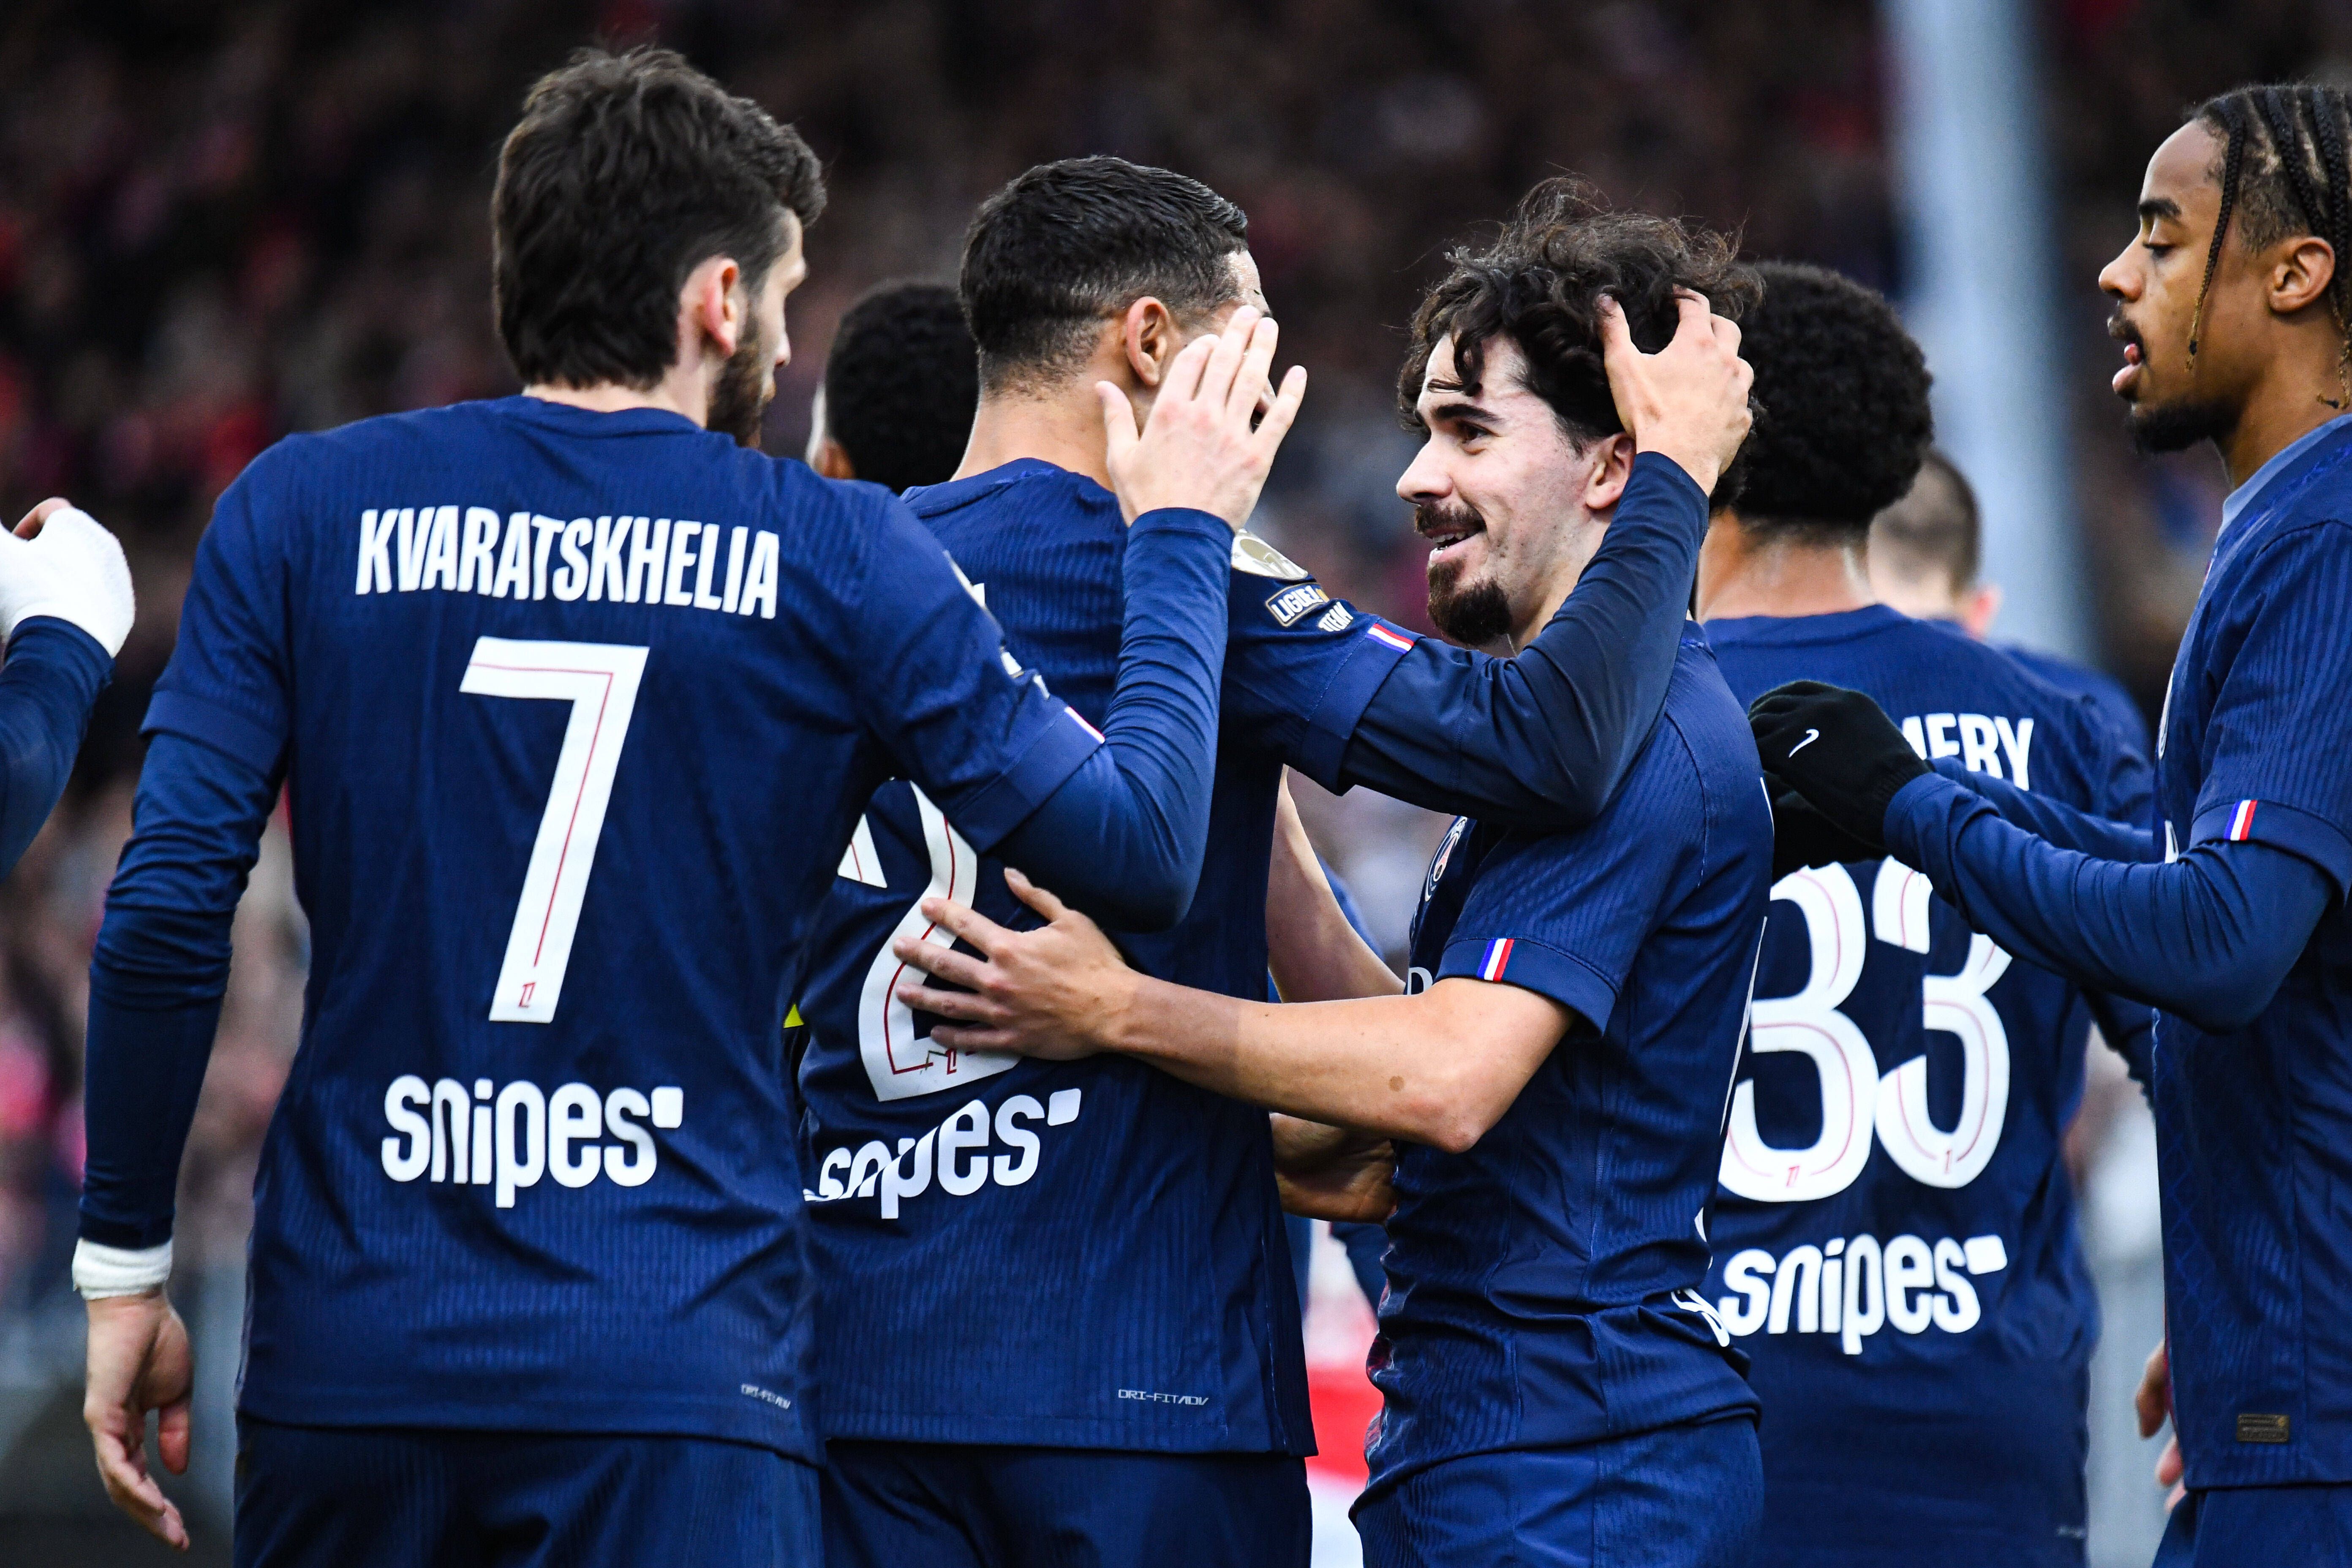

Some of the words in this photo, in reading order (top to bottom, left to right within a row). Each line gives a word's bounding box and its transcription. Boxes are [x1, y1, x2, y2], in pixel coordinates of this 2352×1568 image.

[355, 505, 780, 619] KVARATSKHELIA
[459, 636, 651, 1024] 7
[1717, 855, 2013, 1202] 33
[381, 1075, 658, 1209] snipes
[1717, 1233, 1981, 1355] snipes
